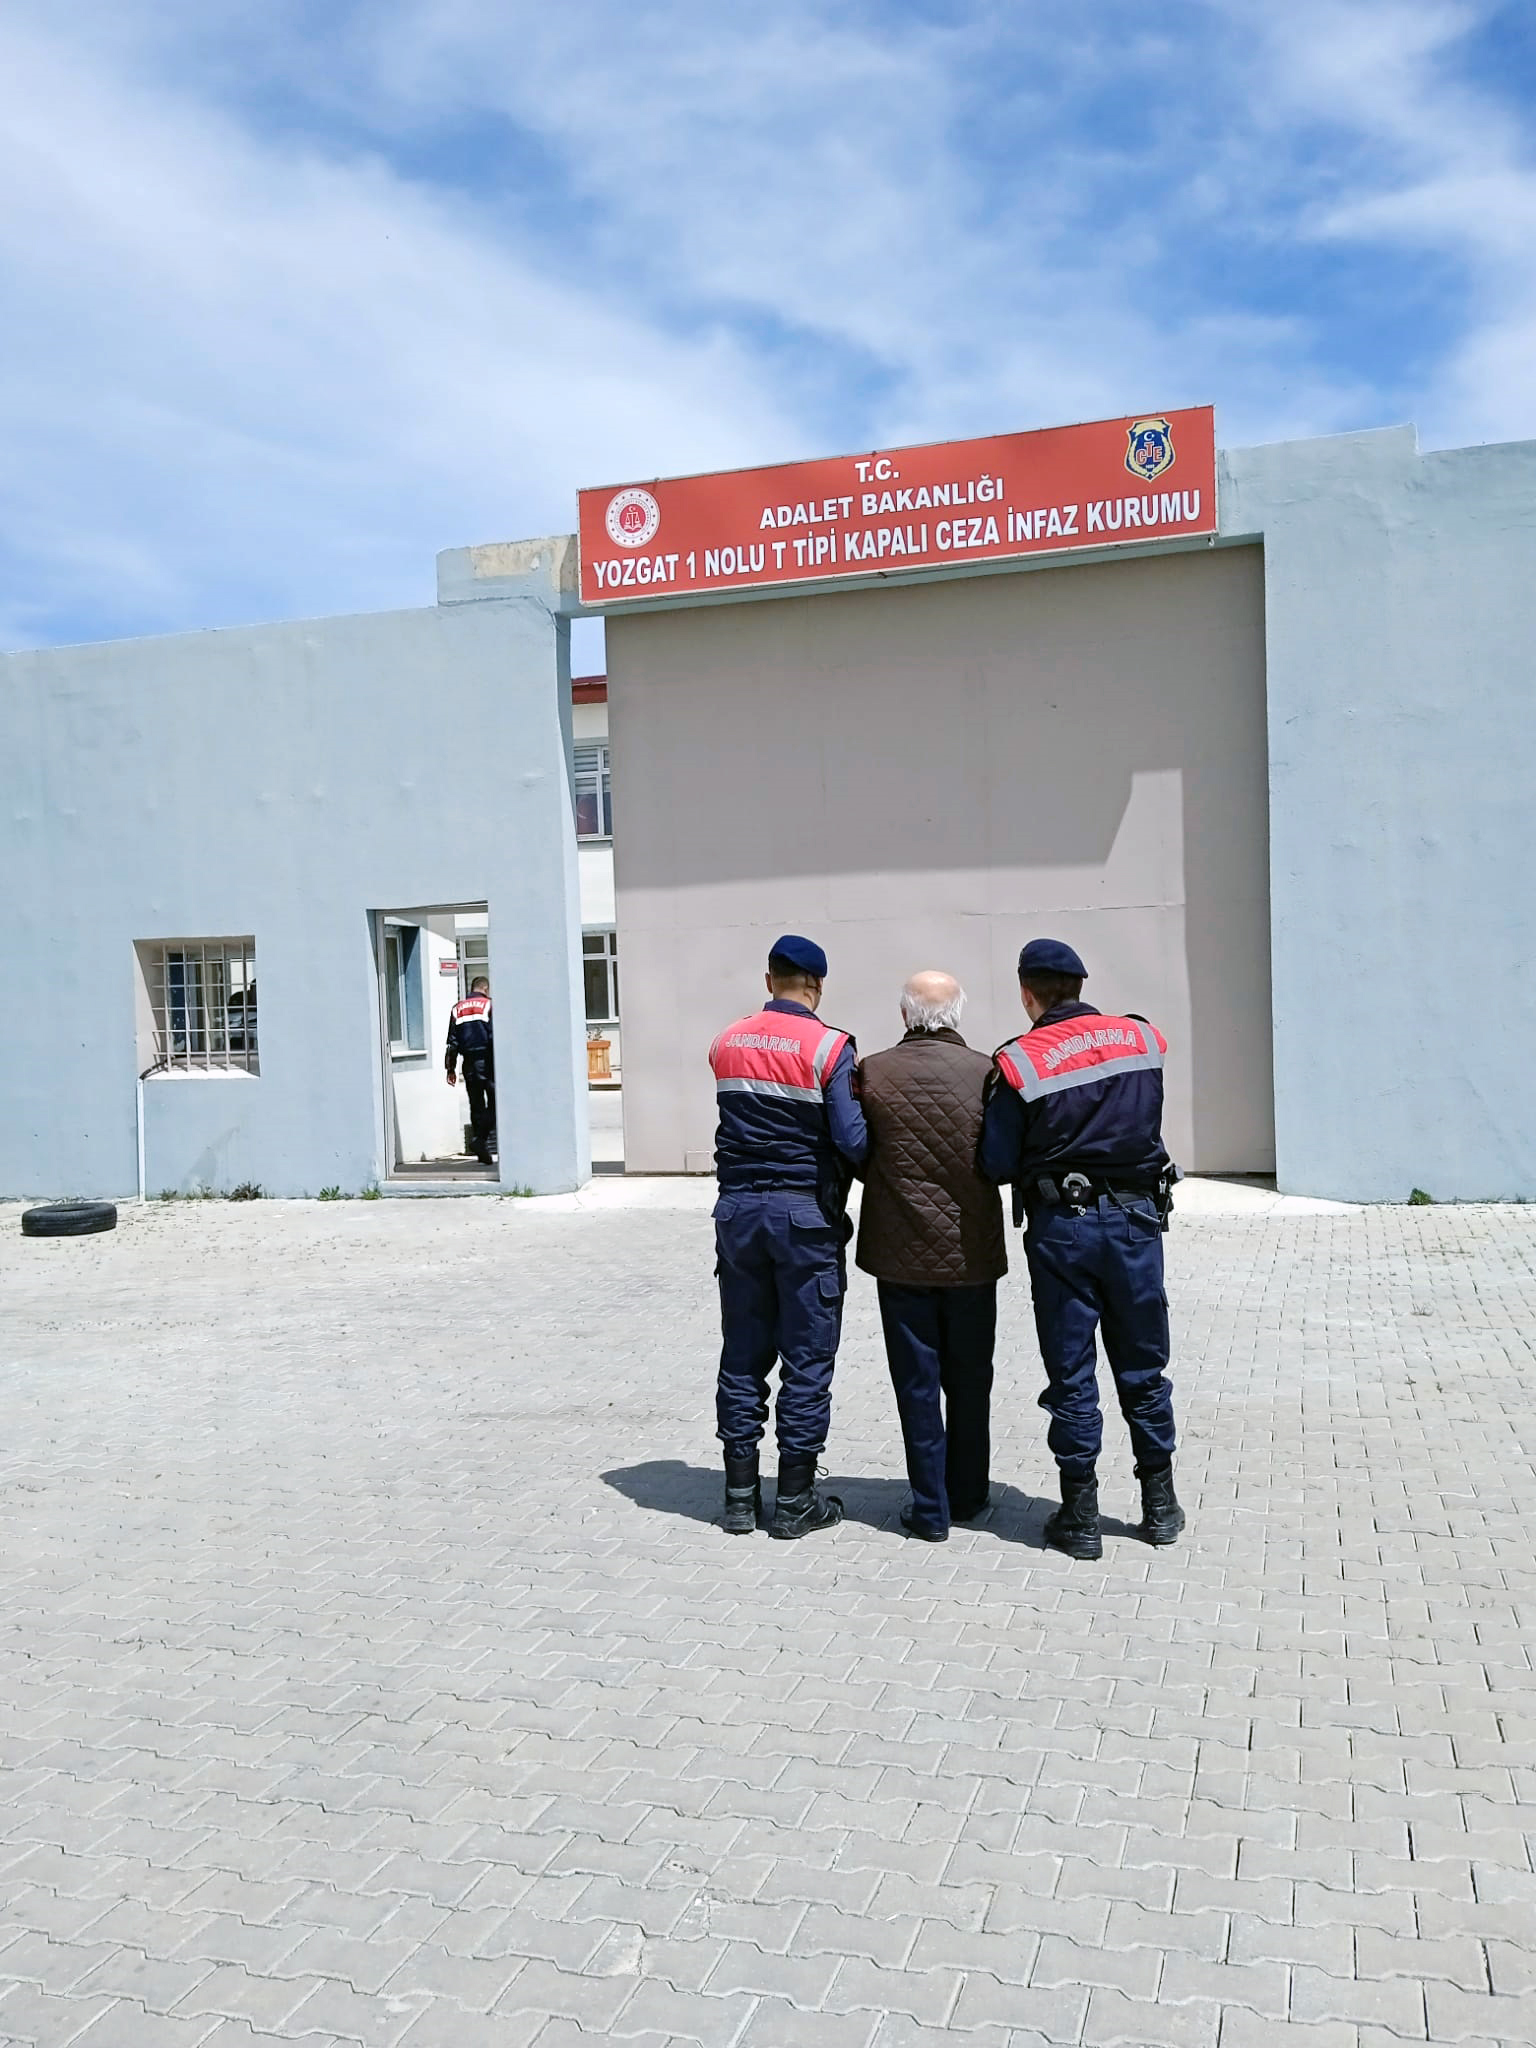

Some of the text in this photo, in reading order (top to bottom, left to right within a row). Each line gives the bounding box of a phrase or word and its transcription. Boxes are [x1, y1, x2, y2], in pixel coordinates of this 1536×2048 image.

[855, 459, 900, 483] T.C.
[759, 474, 1004, 530] ADALET BAKANLIĞI
[593, 489, 1201, 589] YOZGAT 1 NOLU T TİPİ KAPALI CEZA İNFAZ KURUMU
[725, 1033, 801, 1055] JANDARMA
[1041, 1028, 1137, 1070] JANDARMA
